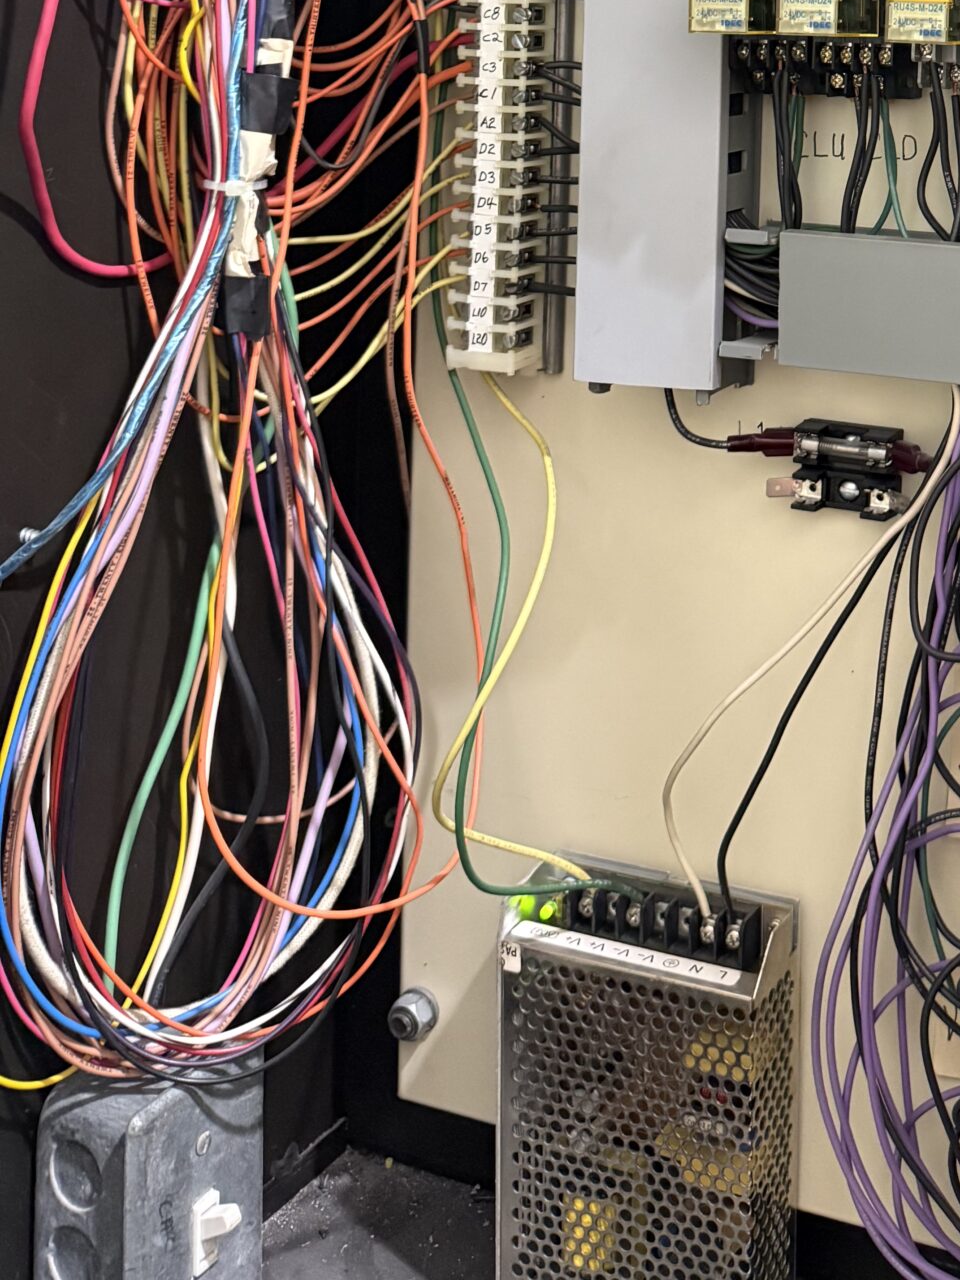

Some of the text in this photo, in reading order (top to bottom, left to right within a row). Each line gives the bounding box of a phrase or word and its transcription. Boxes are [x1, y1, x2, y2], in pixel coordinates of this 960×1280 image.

[483, 6, 500, 20] C8
[482, 32, 503, 43] C2
[482, 62, 497, 73] C3
[480, 116, 496, 129] A2
[479, 143, 496, 155] D2
[478, 171, 495, 184] D3
[477, 197, 497, 209] D4
[474, 223, 492, 236] D5
[474, 251, 489, 263] D6
[473, 281, 488, 291] D7
[689, 964, 703, 974] N
[719, 970, 728, 980] L
